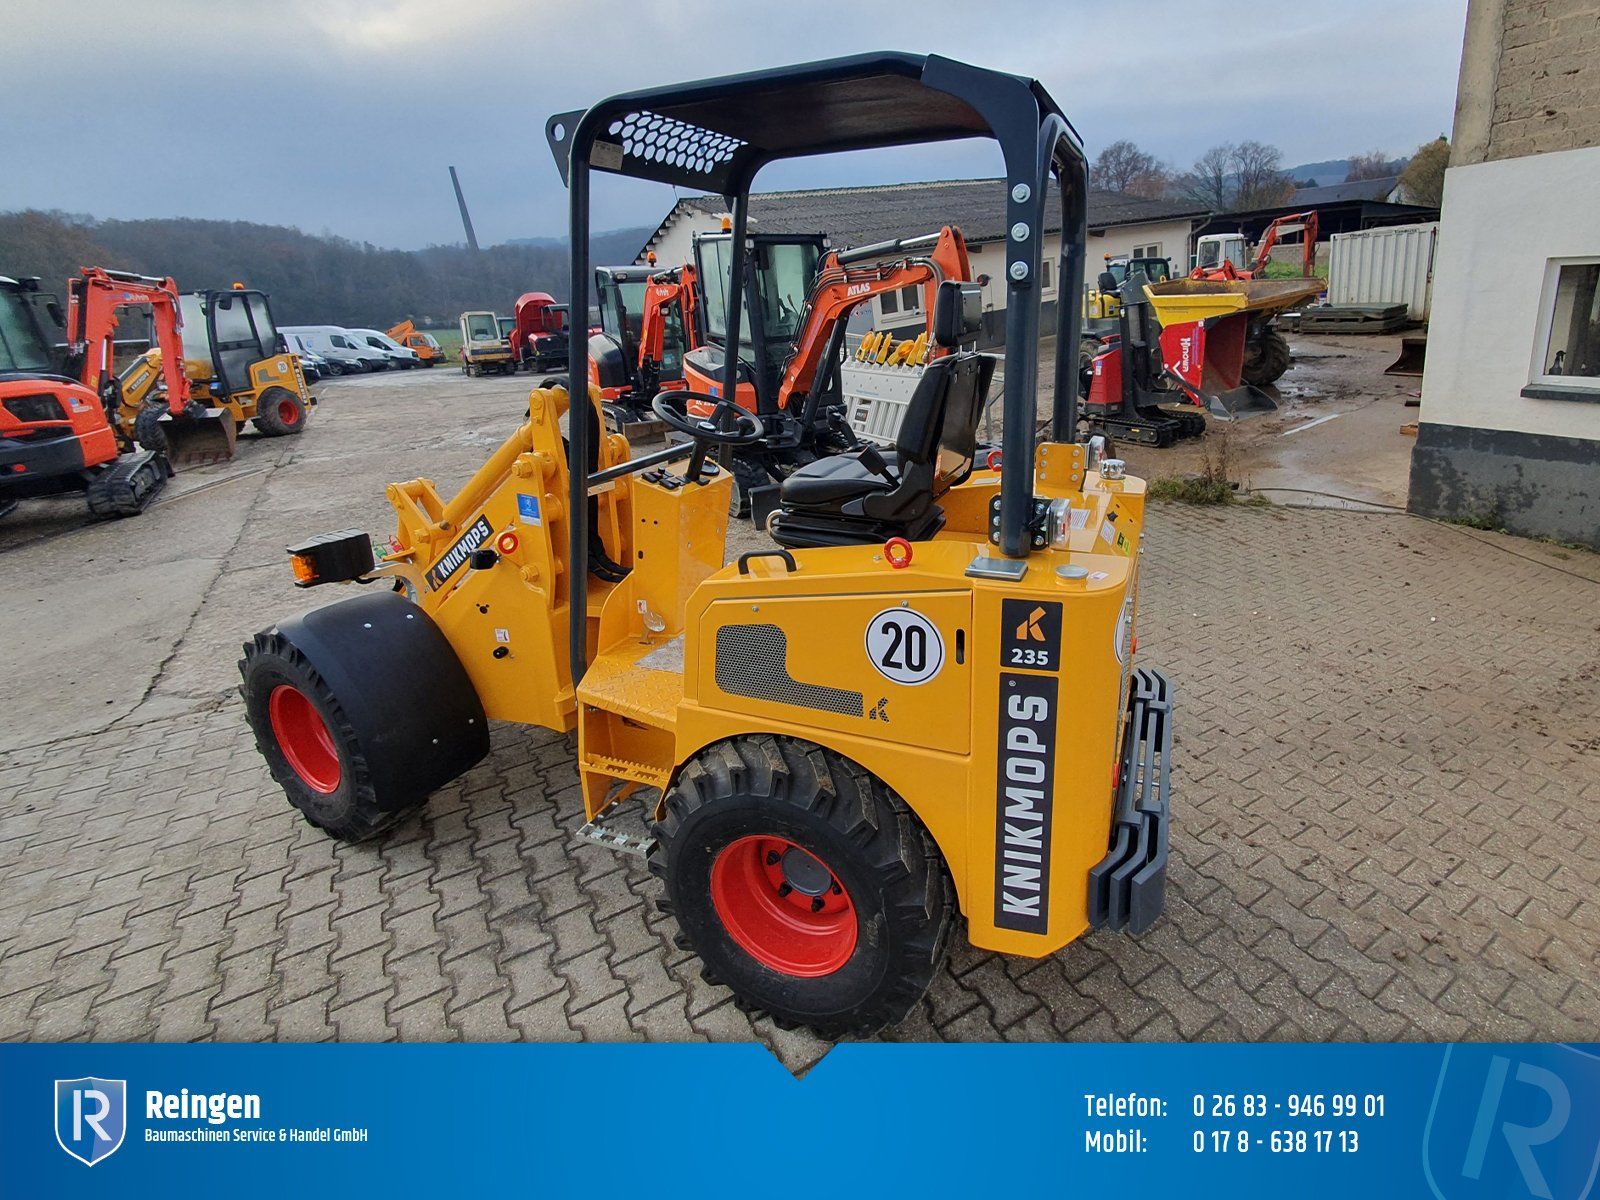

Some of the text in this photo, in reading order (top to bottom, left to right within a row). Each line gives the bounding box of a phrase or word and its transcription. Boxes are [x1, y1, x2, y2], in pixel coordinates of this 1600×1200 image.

[847, 282, 871, 297] ATLAS
[438, 520, 489, 578] KNIKMOPS
[881, 621, 927, 673] 20
[1011, 648, 1049, 666] 235
[1002, 694, 1048, 917] KNIKMOPS
